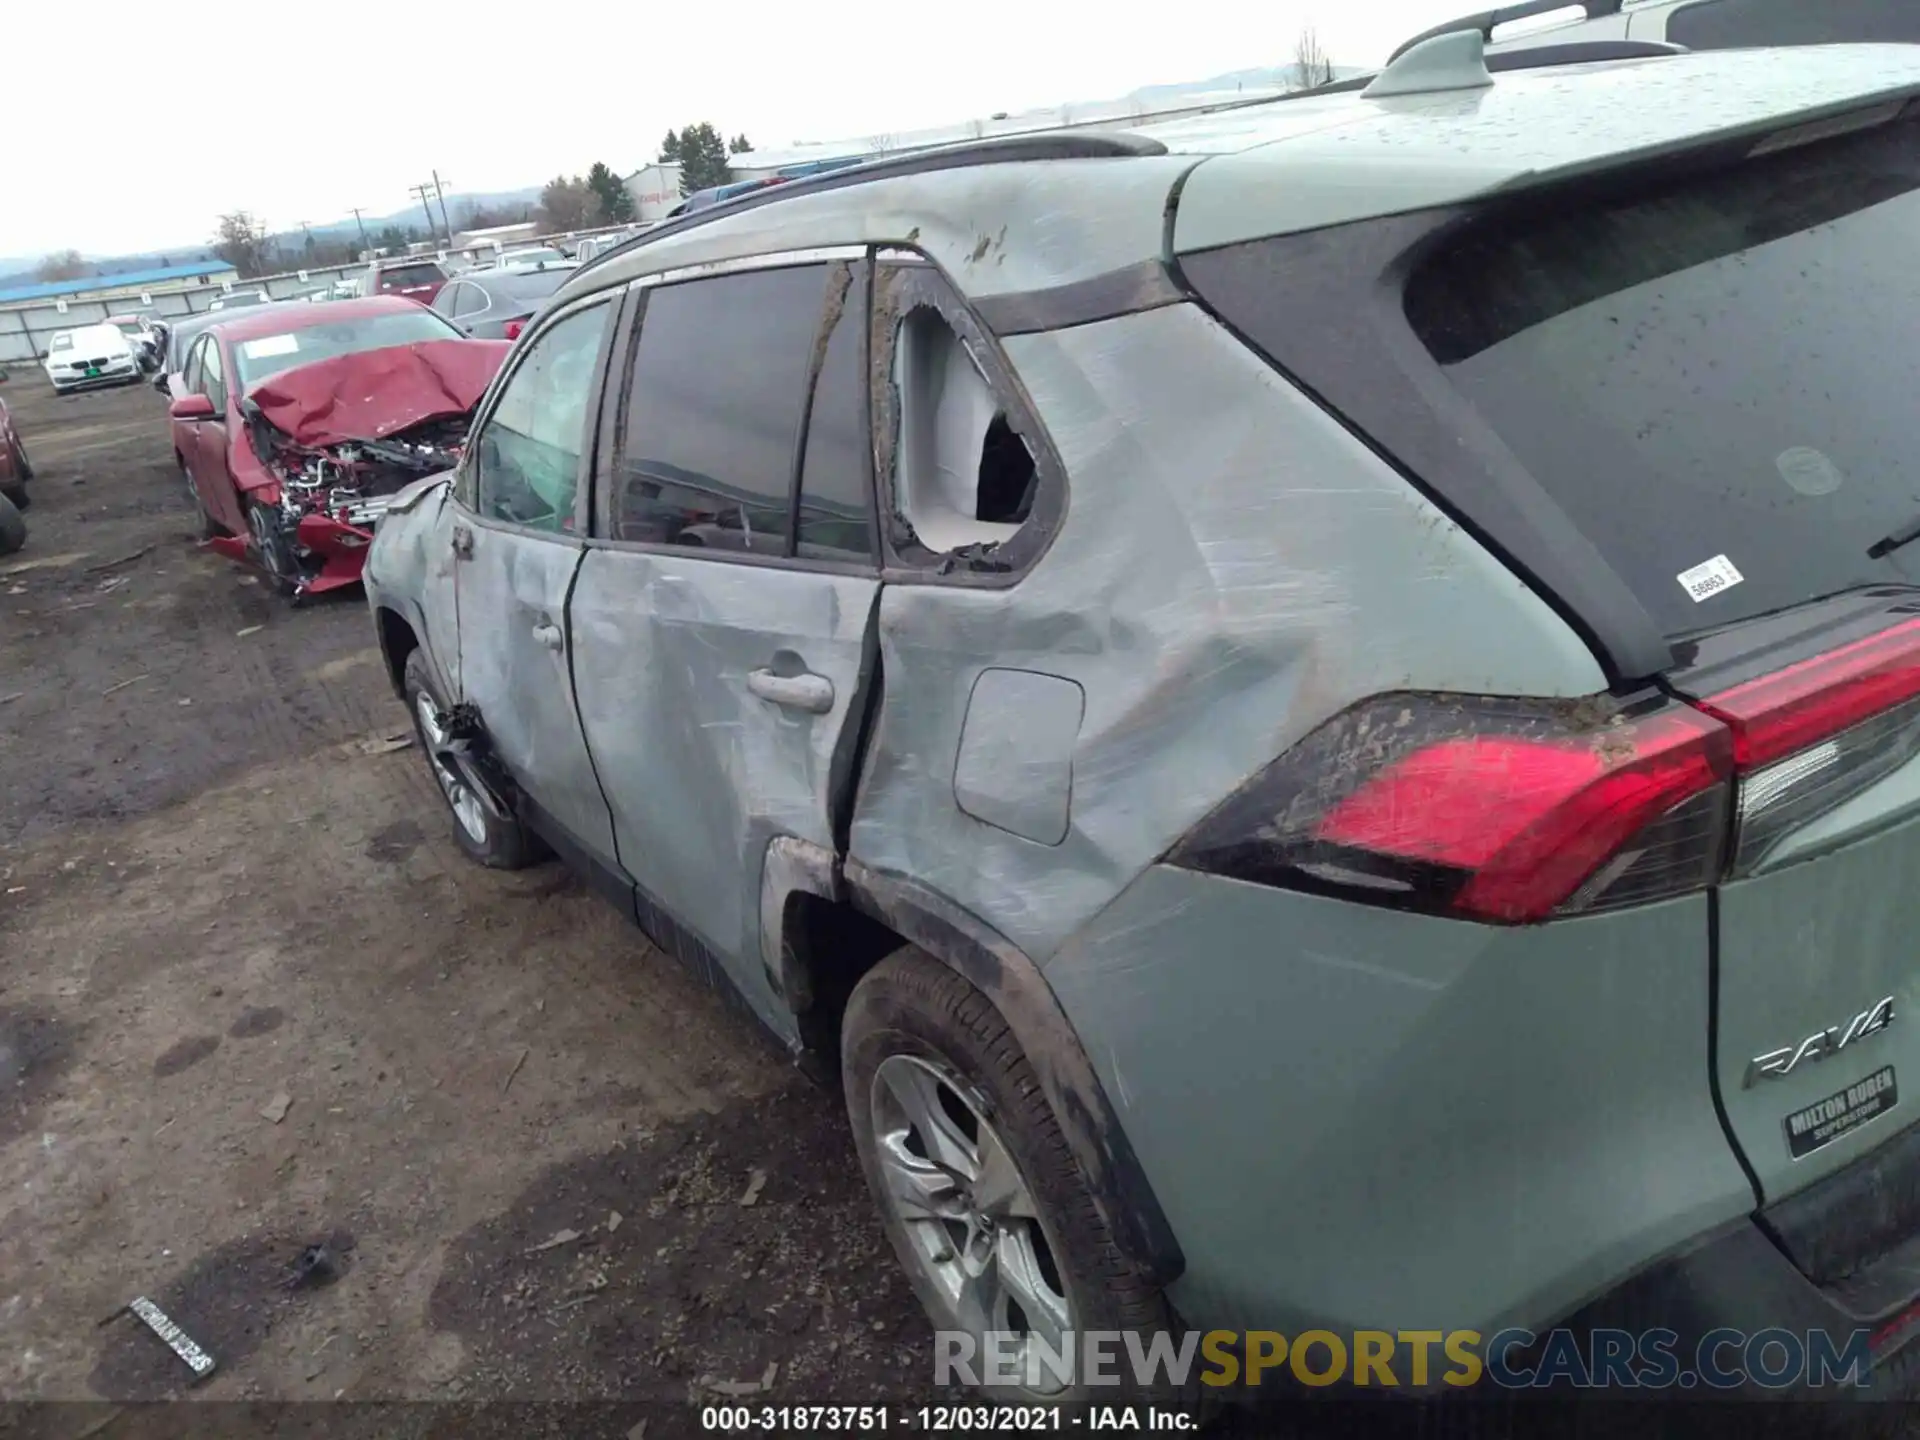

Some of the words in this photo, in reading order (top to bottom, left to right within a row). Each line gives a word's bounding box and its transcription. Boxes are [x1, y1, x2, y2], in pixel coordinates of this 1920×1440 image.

[1741, 996, 1896, 1091] RAV4
[1790, 1093, 1847, 1136] MILTON
[1847, 1067, 1893, 1109] RUBEN
